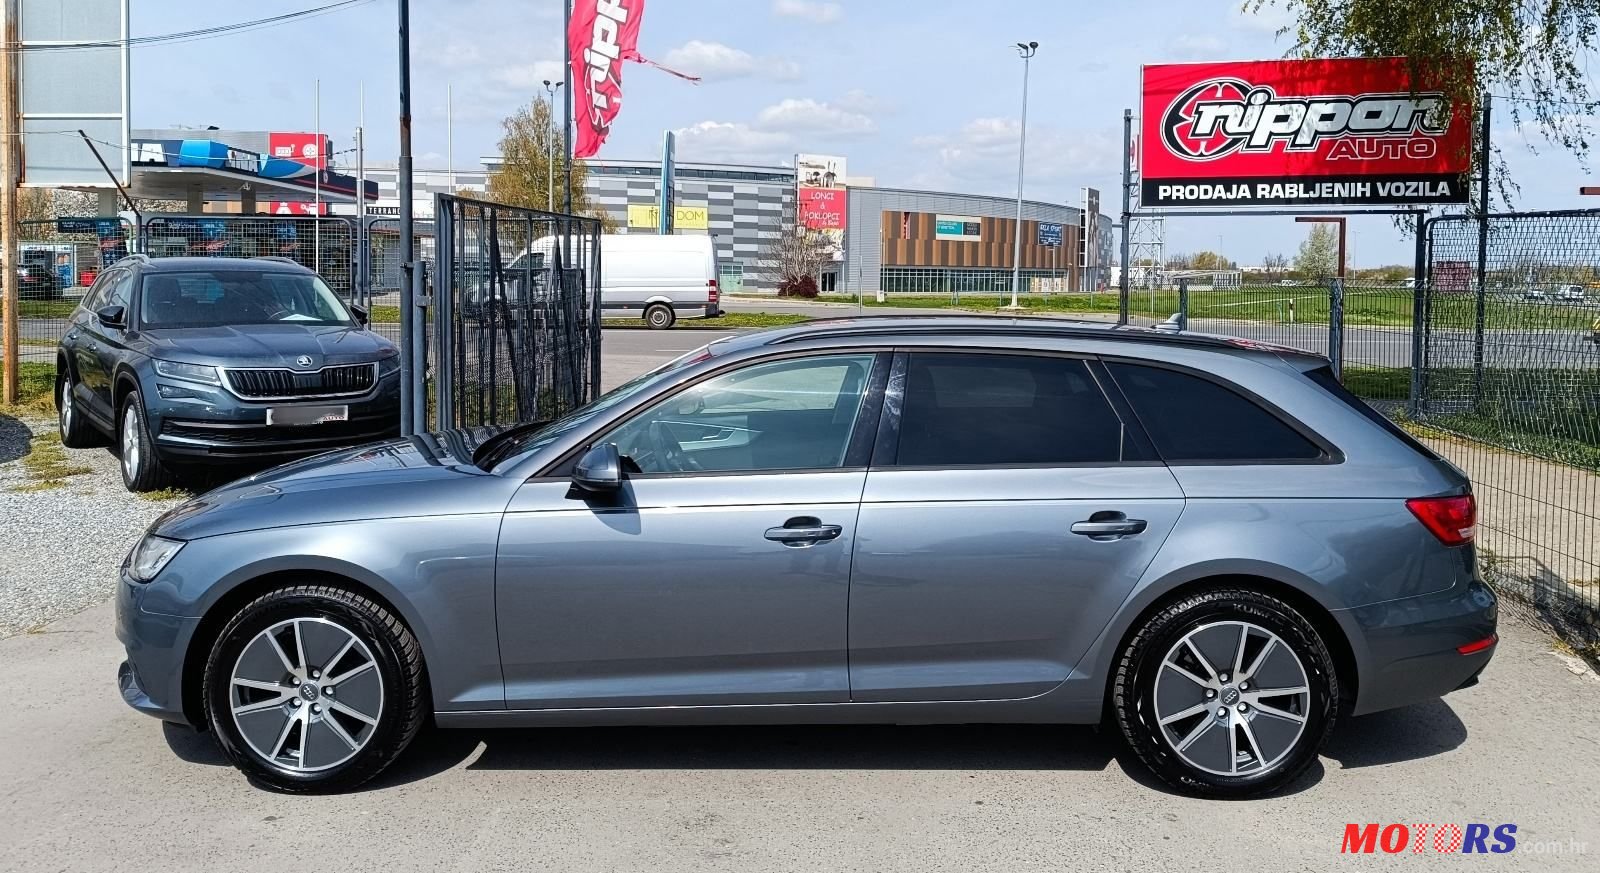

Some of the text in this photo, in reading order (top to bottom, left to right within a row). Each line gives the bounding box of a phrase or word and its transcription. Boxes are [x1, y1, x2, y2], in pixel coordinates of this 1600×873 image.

[1193, 91, 1450, 149] nippon
[1326, 137, 1436, 160] AUTO
[1158, 181, 1450, 200] PRODAJA RABLJENIH VOZILA
[677, 211, 704, 220] DOM
